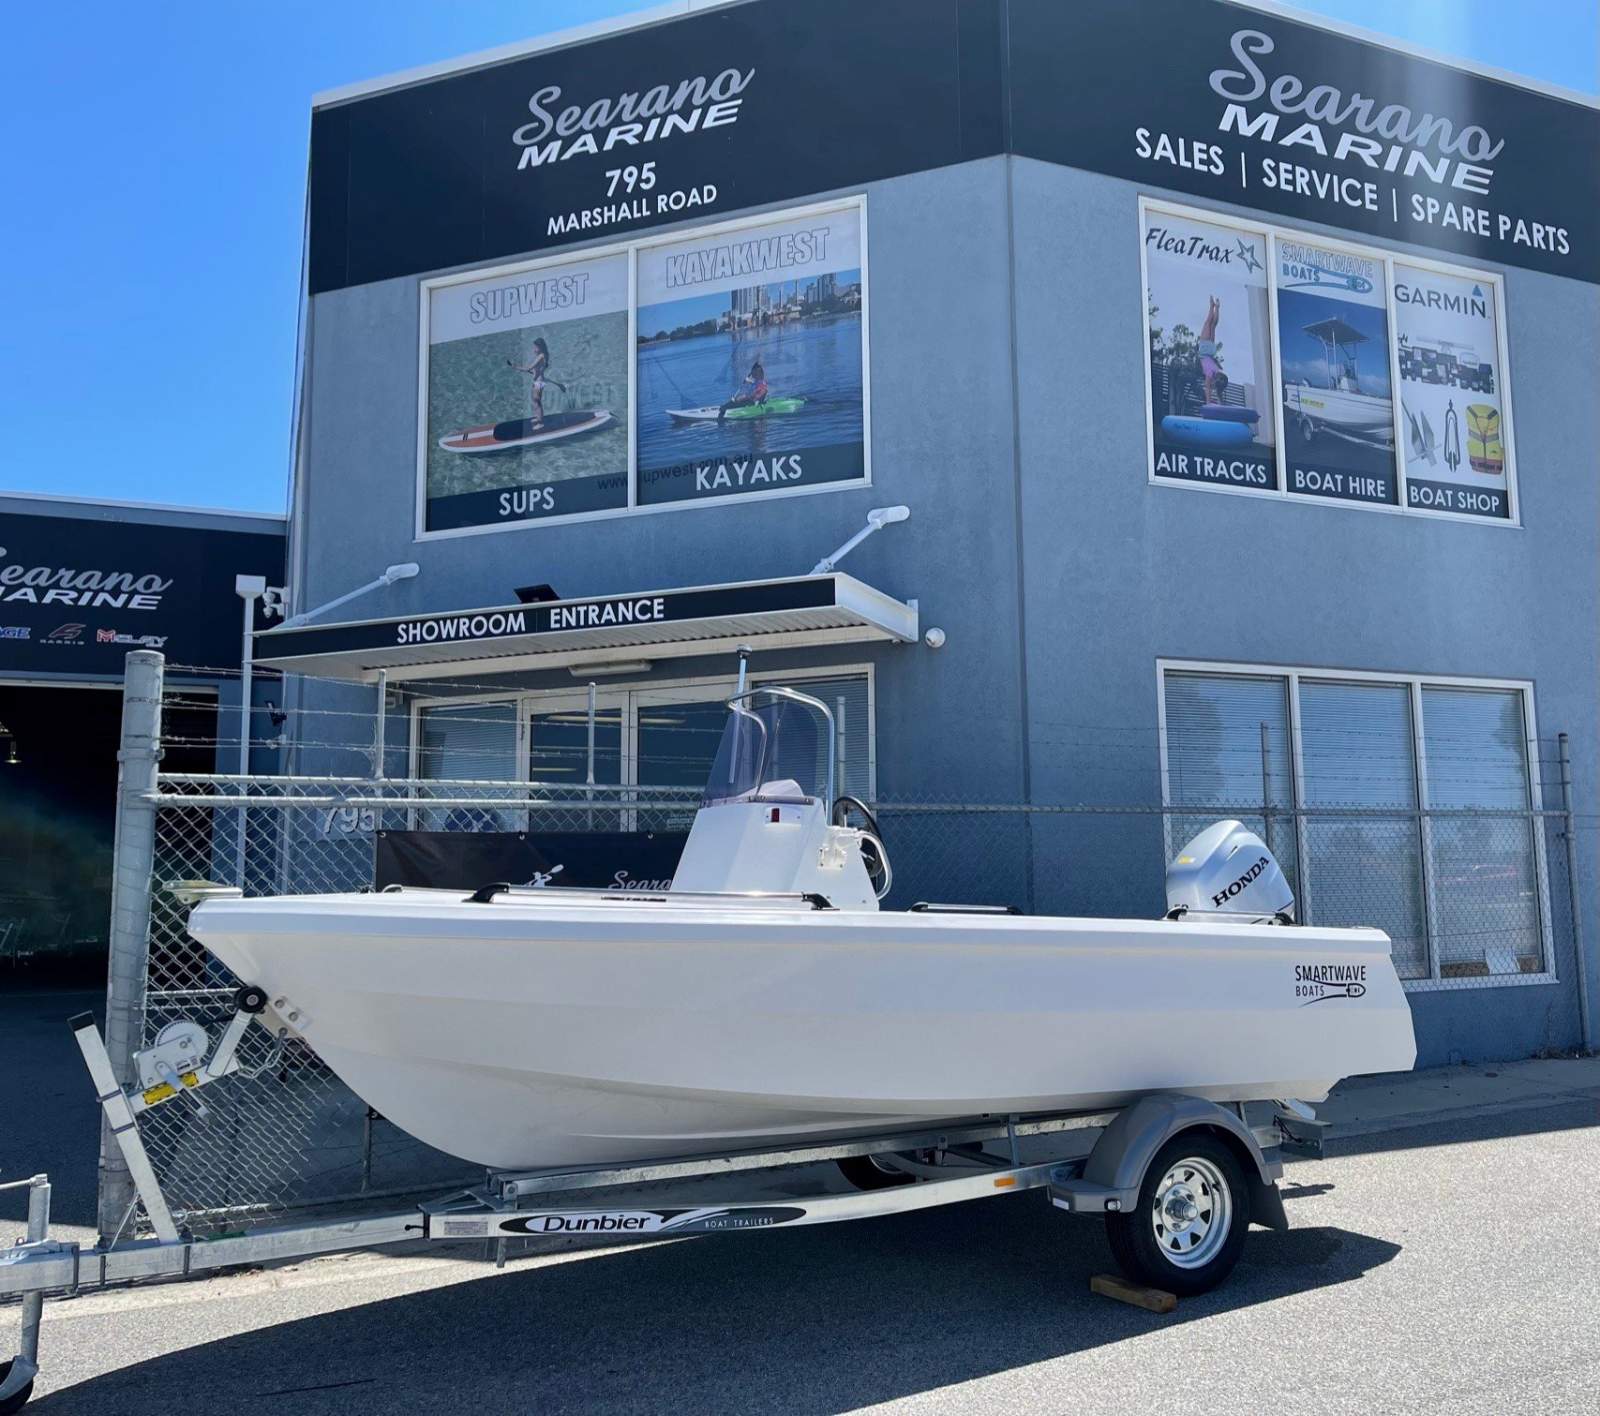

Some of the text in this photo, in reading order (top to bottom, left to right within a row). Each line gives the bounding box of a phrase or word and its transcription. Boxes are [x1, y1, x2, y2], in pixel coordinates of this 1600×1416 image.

[512, 68, 755, 146] Searano
[1208, 29, 1505, 162] Searano
[517, 99, 742, 170] MARINE
[1218, 103, 1494, 195] MARINE
[605, 161, 656, 197] 795
[1135, 128, 1570, 255] SALES SERVICE SPARE PARTS
[547, 184, 717, 235] MARSHALL ROAD
[665, 227, 830, 288] KAYAKWEST
[1281, 242, 1374, 278] SMARTWAVE
[1282, 263, 1320, 282] BOATS
[469, 273, 589, 324] SUPWEST
[1394, 284, 1487, 319] GARMIN
[695, 454, 802, 492] KAYAKS
[1156, 452, 1267, 484] AIR TRACKS
[1295, 469, 1386, 498] BOAT HIRE
[498, 487, 555, 516] SUPS
[1410, 486, 1500, 512] BOAT SHOP
[0, 547, 174, 594] earano
[0, 586, 163, 610] ARINE
[396, 598, 665, 645] SHOWROOM ENTRANCE
[1211, 856, 1270, 908] HONDA
[1295, 964, 1366, 982] SMARTWAVE
[1295, 985, 1325, 997] BOATS
[543, 1213, 774, 1232] Dunbier BOAT TRAILERS
